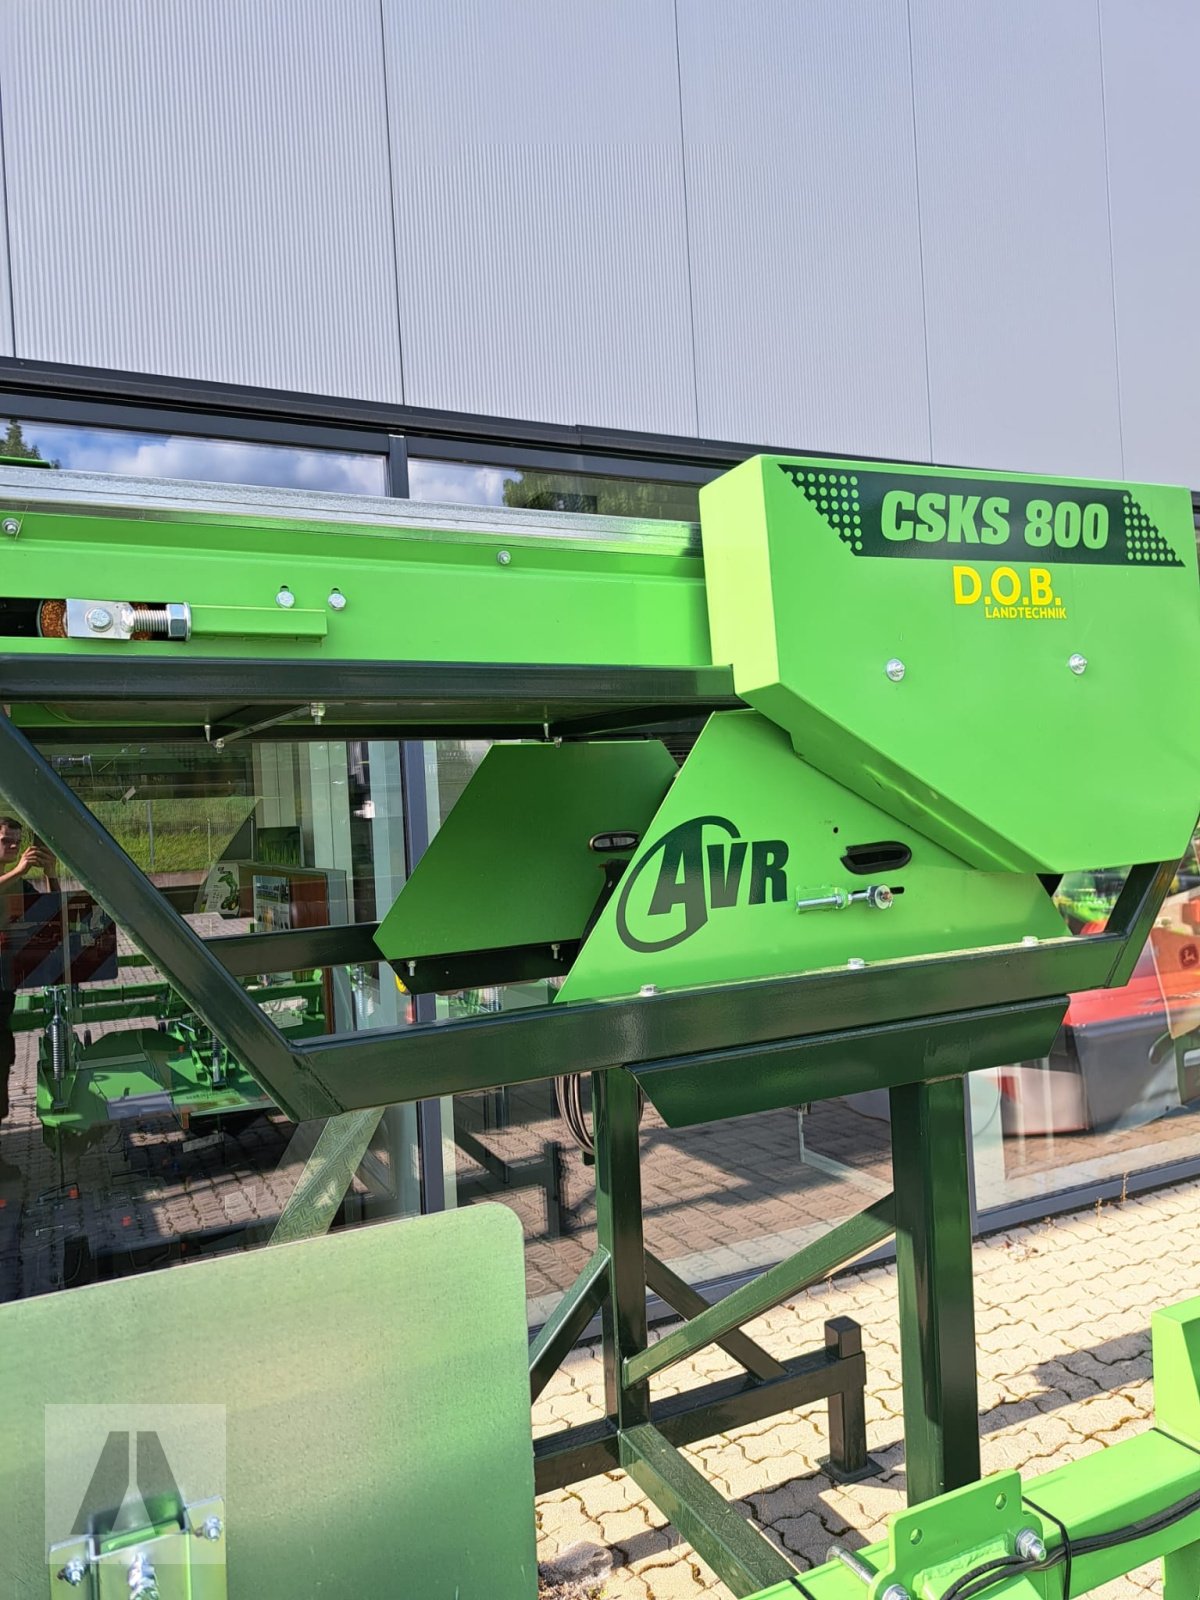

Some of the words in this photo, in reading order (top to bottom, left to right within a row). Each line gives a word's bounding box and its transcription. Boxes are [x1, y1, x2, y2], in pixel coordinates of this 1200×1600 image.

[881, 490, 1010, 545] CSKS
[1024, 500, 1109, 549] 800
[953, 566, 1061, 606] D.O.B.
[985, 606, 1067, 619] LANDTECHNIK
[616, 815, 789, 953] AVR
